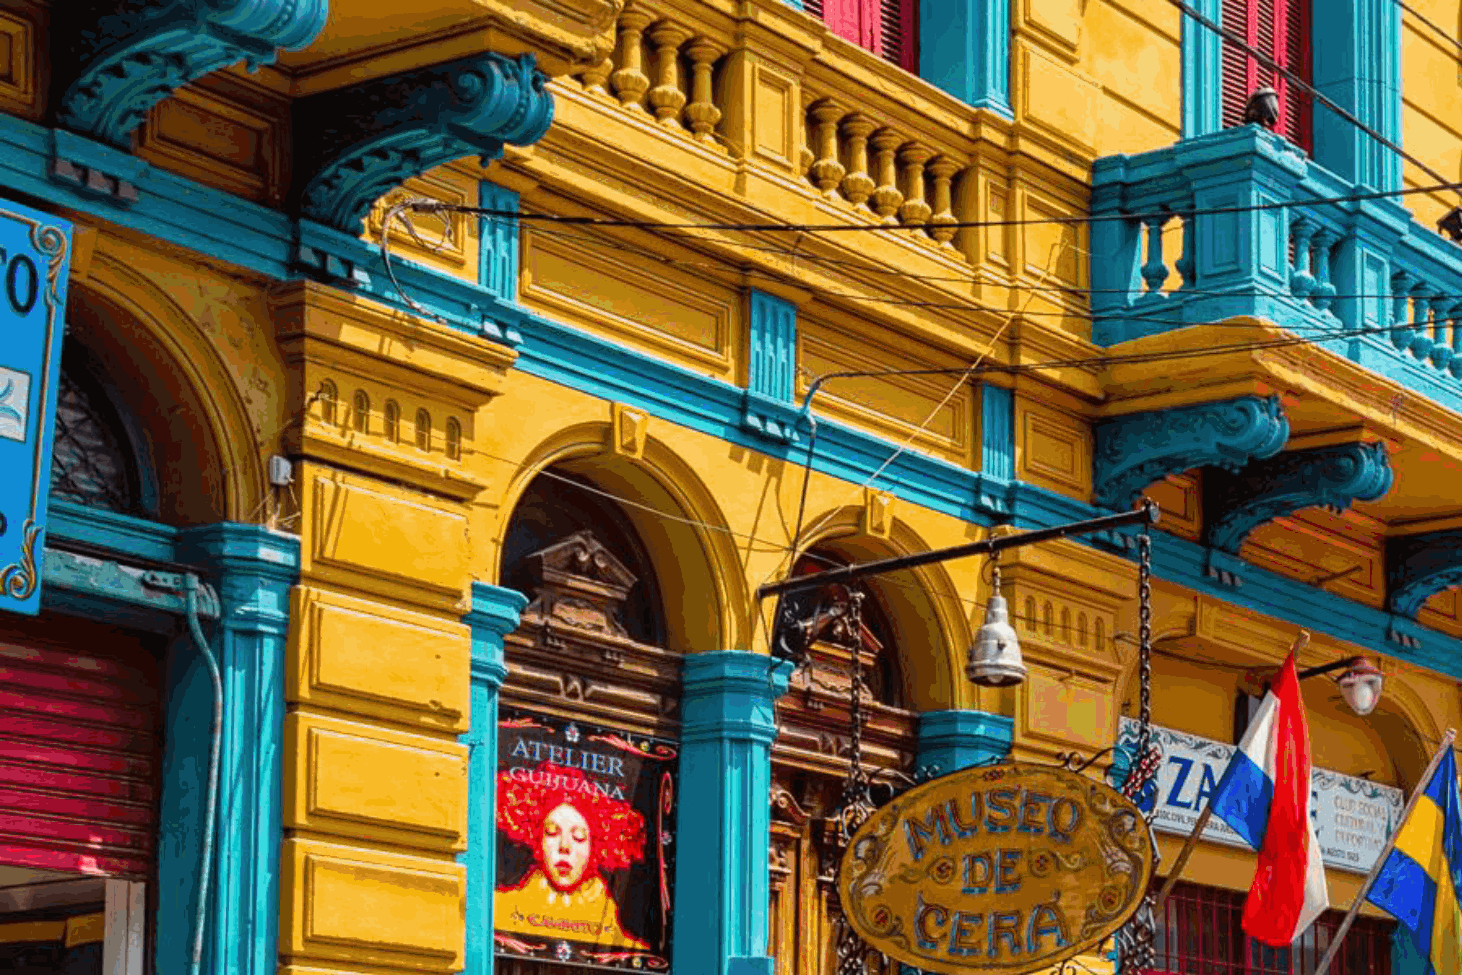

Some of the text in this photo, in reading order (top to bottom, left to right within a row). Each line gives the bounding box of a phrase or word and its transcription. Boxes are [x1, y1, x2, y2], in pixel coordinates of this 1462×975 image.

[511, 737, 624, 777] ATELIER
[903, 788, 1082, 860] MUSEO
[961, 849, 1022, 895] DE
[914, 893, 1073, 957] CERA
